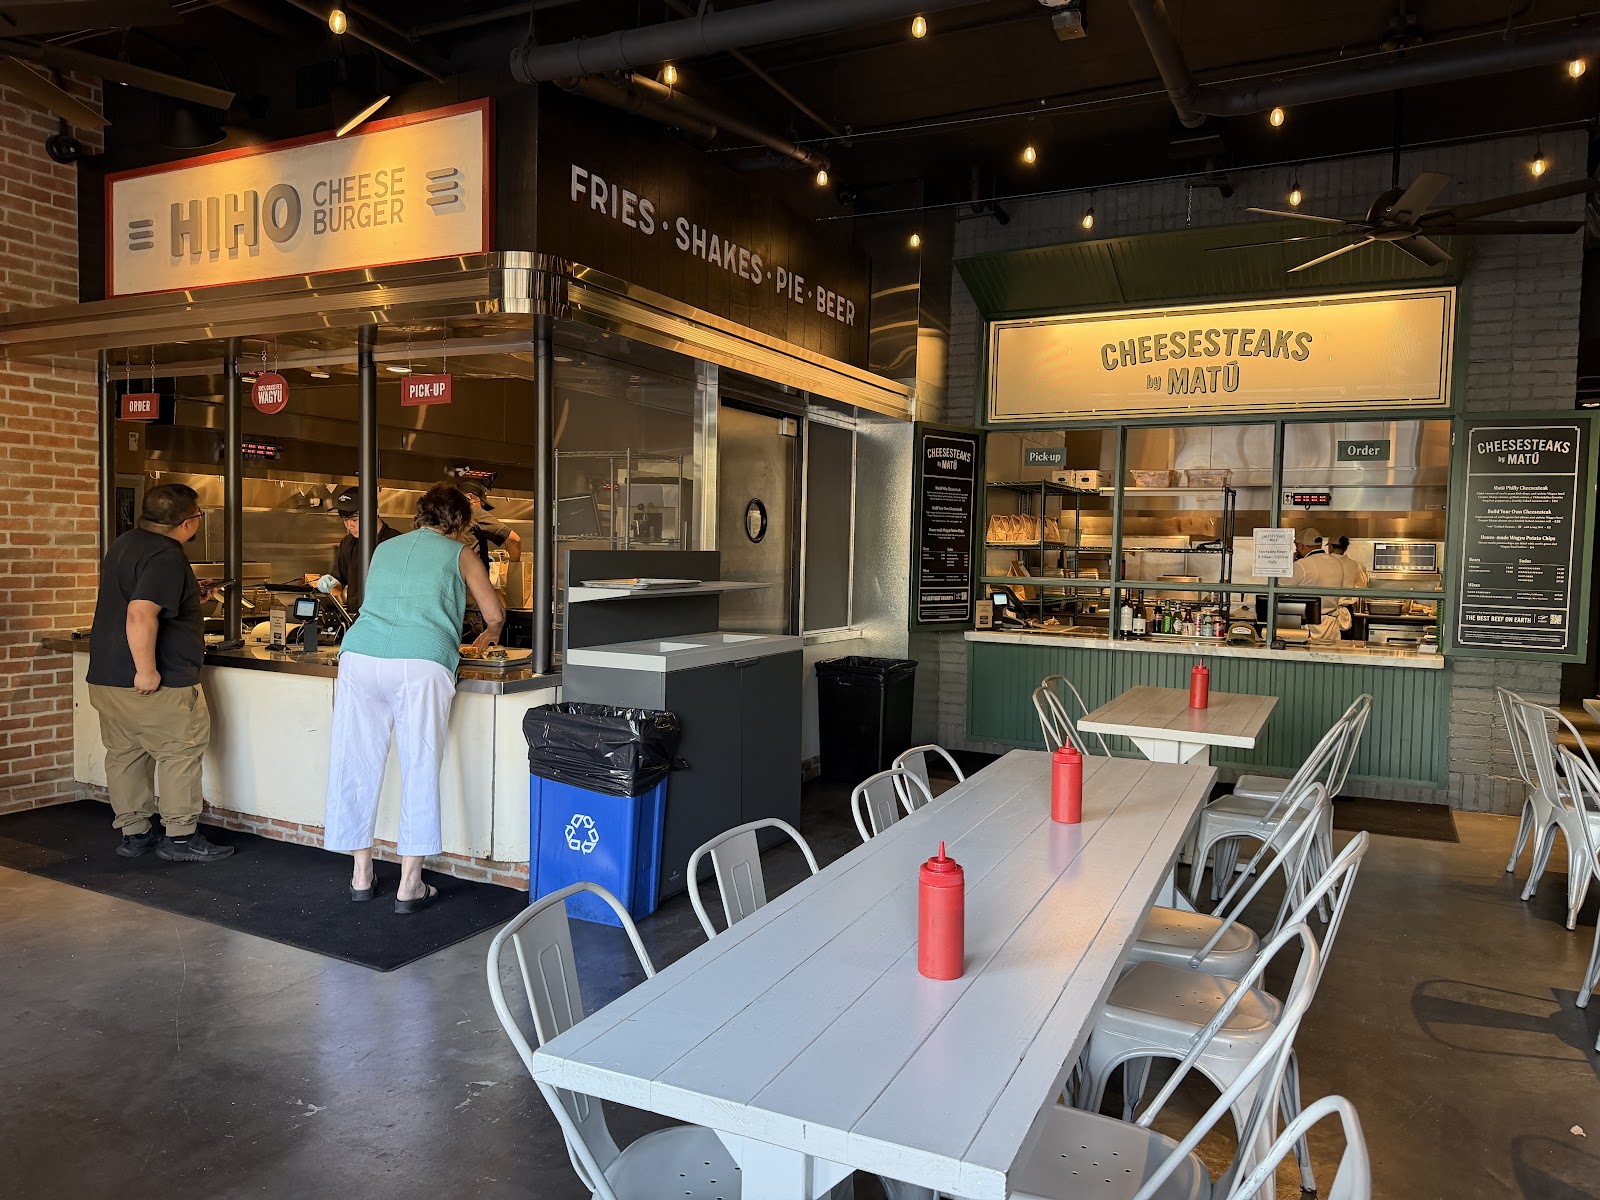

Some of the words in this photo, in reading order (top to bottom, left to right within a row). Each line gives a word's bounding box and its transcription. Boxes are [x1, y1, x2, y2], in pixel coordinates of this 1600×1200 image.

[170, 183, 302, 258] HIHO
[312, 166, 406, 207] CHEESE
[312, 197, 404, 236] BURGER
[570, 163, 656, 236] FRIES
[675, 216, 764, 286] SHAKES
[775, 265, 805, 305] PIE
[816, 284, 856, 327] BEER
[1100, 328, 1313, 371] CHEESESTEAKS
[1146, 374, 1162, 391] by
[1167, 360, 1240, 395] MATÚ
[258, 389, 283, 405] WAGYU
[409, 382, 446, 399] PICK-UP
[129, 400, 151, 413] ORDER
[1347, 444, 1381, 456] Order
[1477, 438, 1571, 454] CHEESESTEAKS
[927, 447, 971, 463] CHEESESTEAKS
[1029, 451, 1061, 463] Pick-up
[1497, 455, 1506, 464] by
